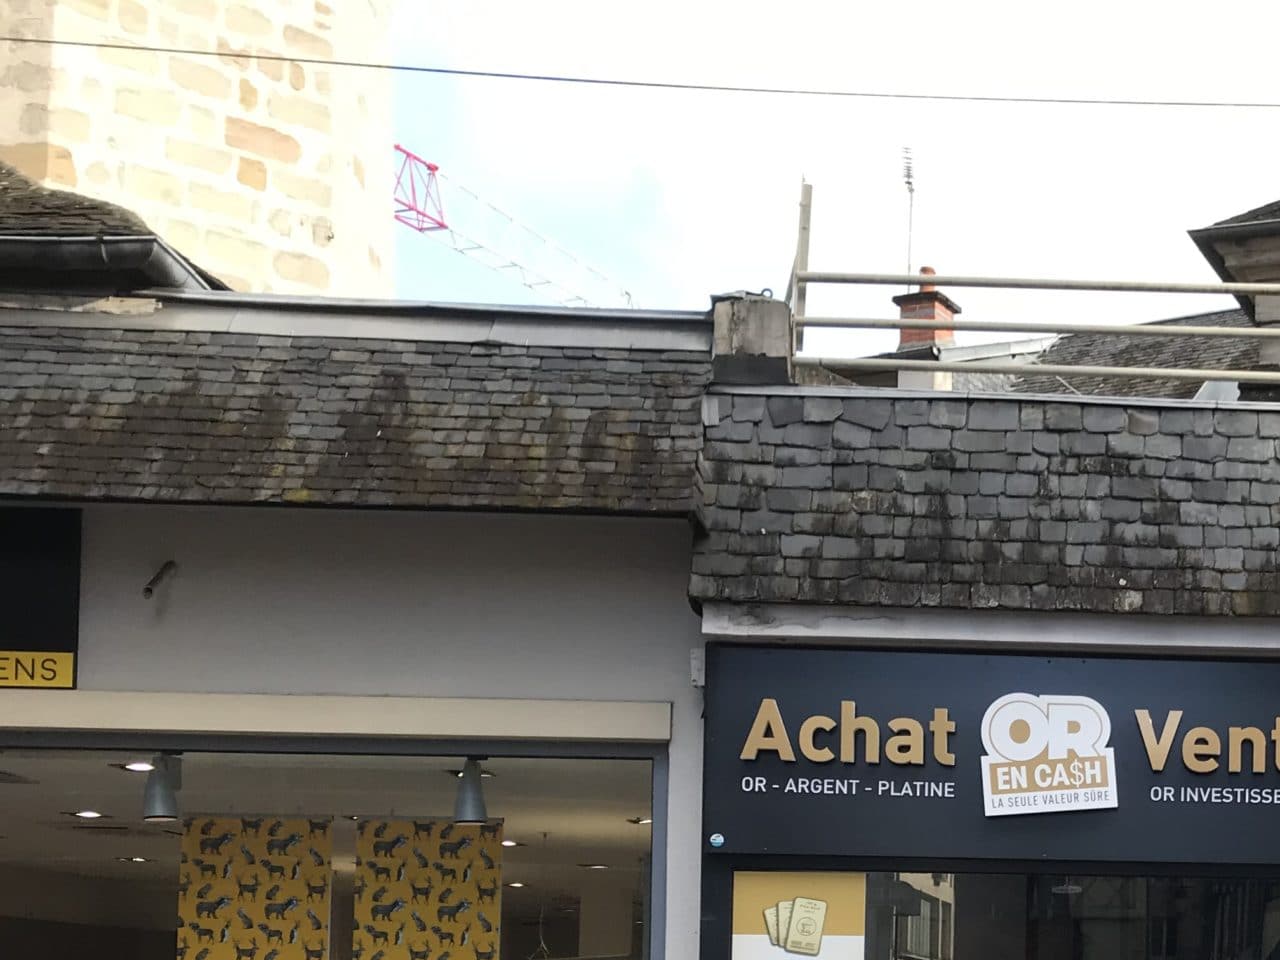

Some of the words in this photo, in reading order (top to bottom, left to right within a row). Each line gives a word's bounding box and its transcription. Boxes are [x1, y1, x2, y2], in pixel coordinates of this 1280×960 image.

[740, 698, 956, 766] Achat
[988, 700, 1103, 761] OR
[741, 777, 766, 792] OR
[784, 778, 860, 795] ARGENT
[878, 780, 955, 797] PLATINE
[997, 765, 1028, 790] EN
[992, 798, 1004, 809] LA
[1008, 796, 1038, 808] SEULE
[1042, 793, 1080, 805] VALEUR
[1150, 786, 1174, 801] OR
